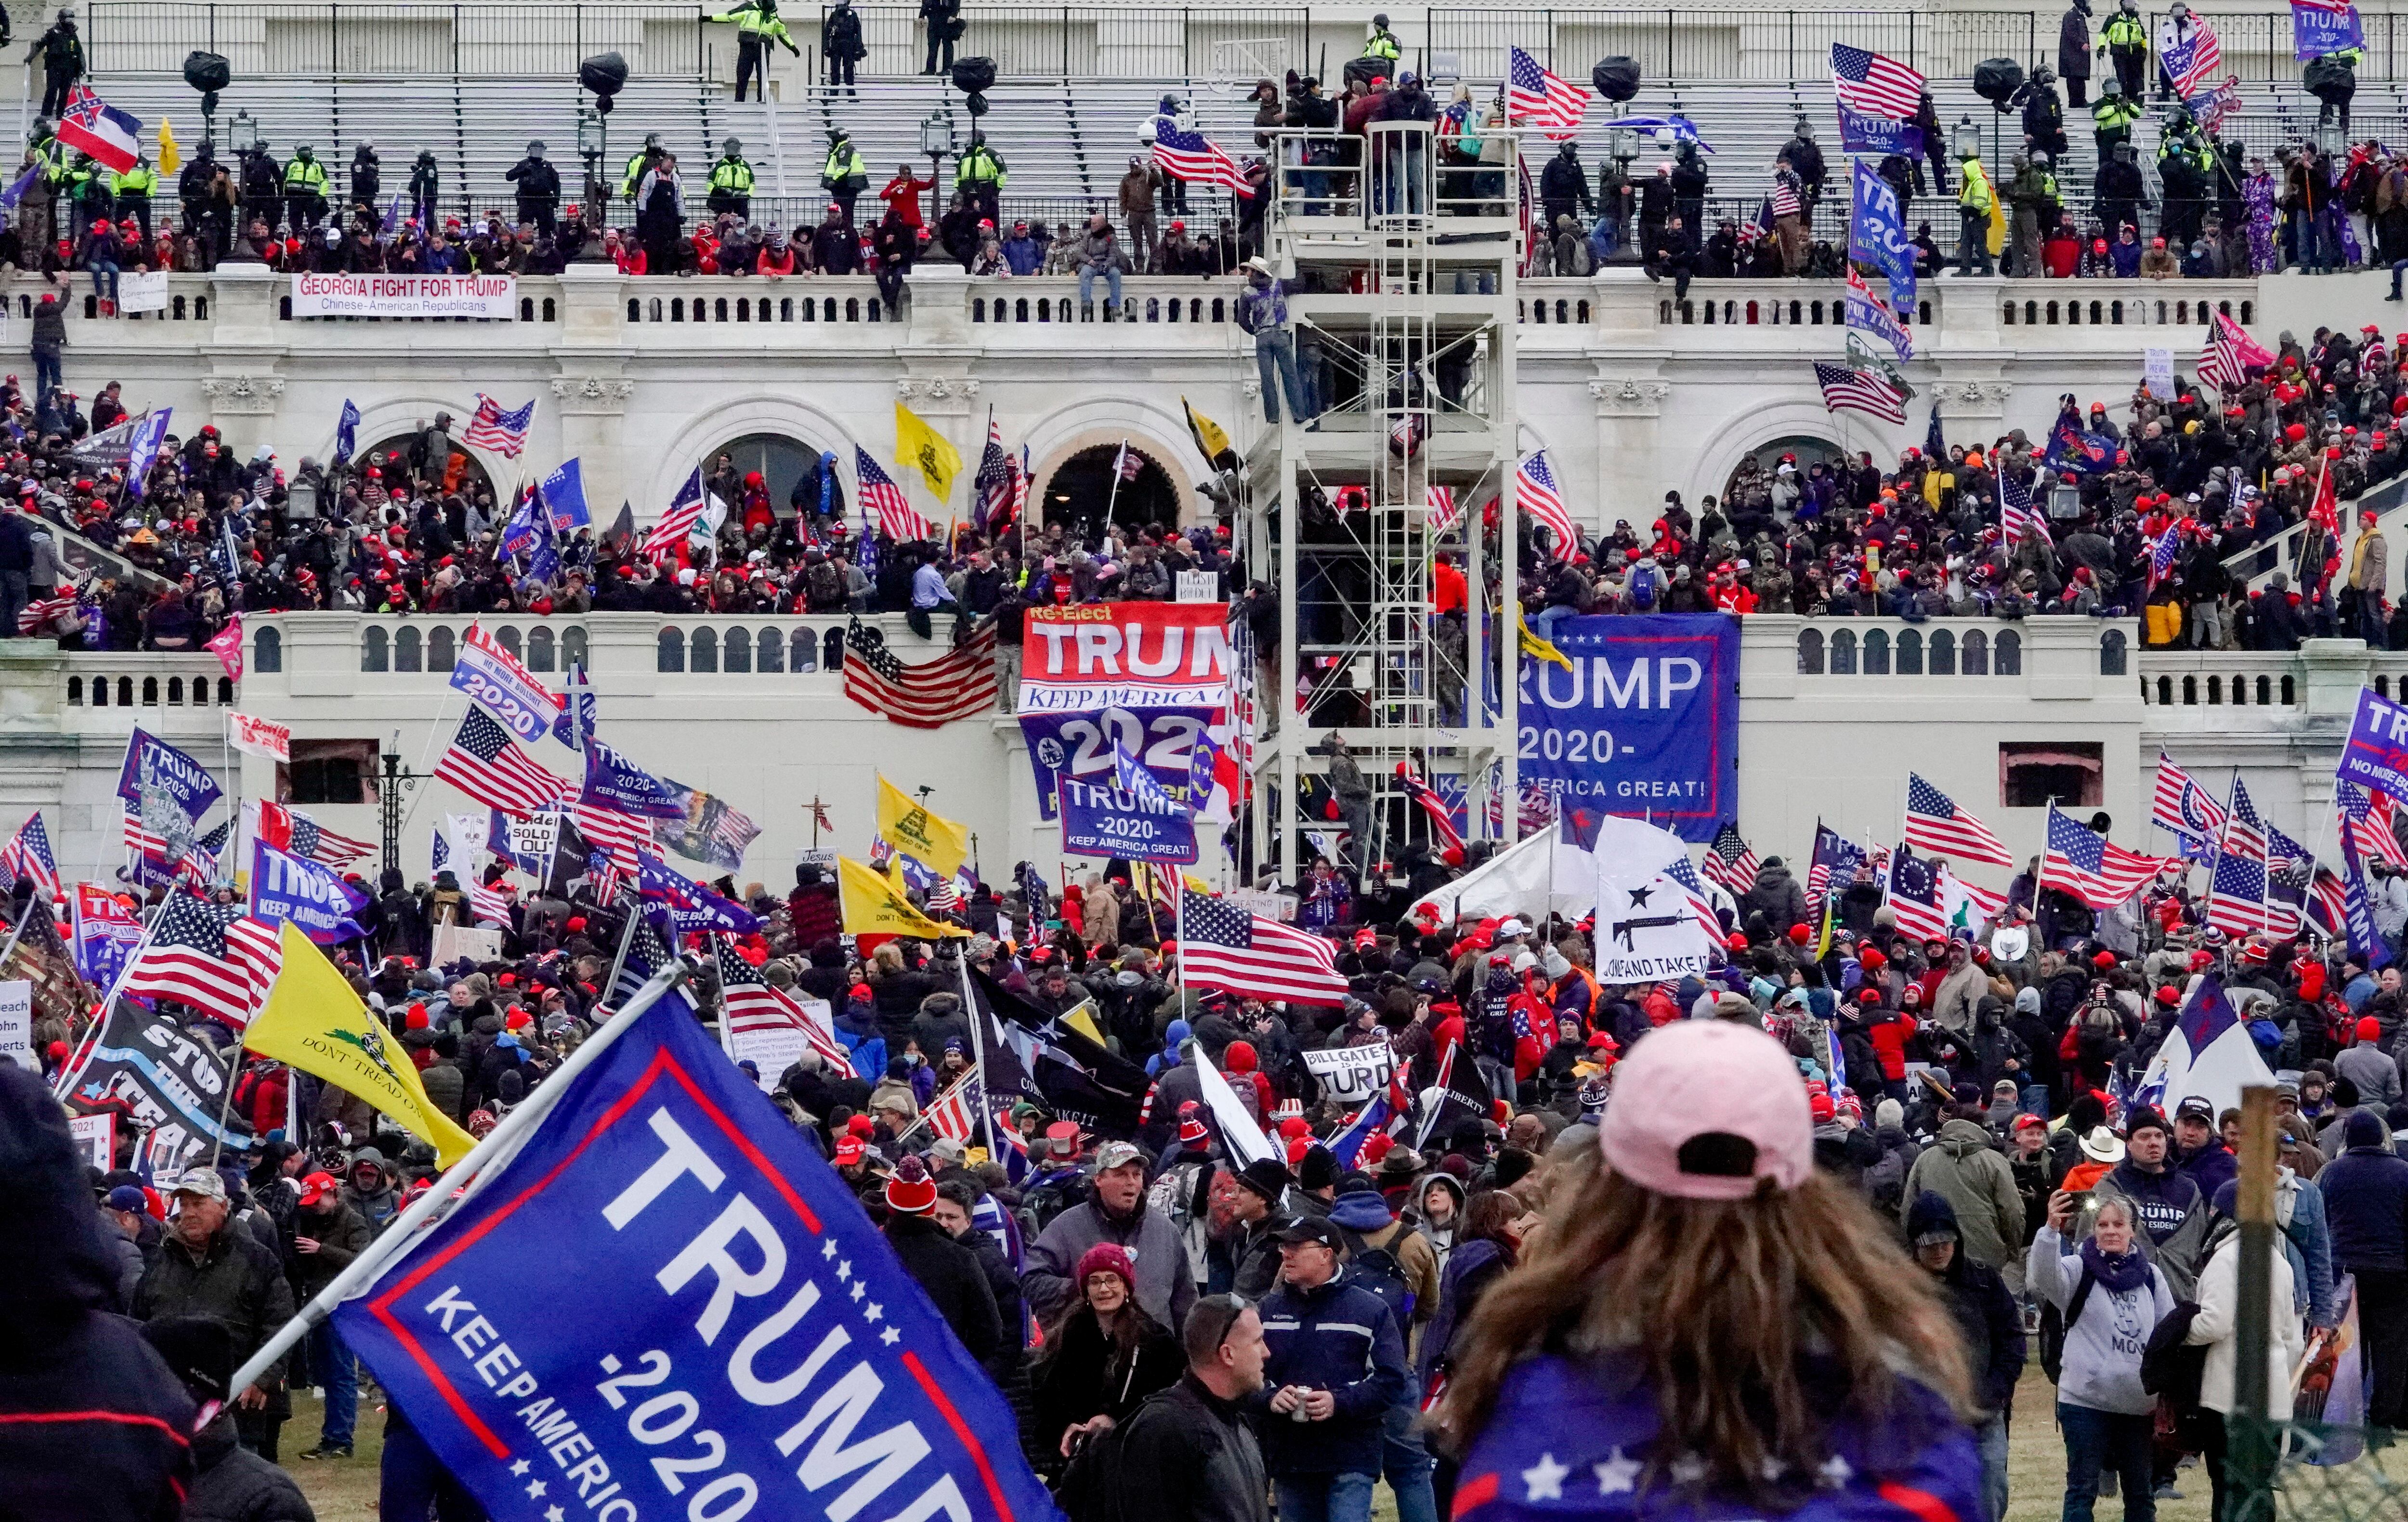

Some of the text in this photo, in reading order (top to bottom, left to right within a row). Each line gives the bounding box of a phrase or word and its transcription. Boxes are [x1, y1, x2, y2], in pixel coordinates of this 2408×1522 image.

[300, 278, 508, 297] GEORGIA FIGHT FOR TRUMP
[321, 298, 486, 313] Chinese-American Republicans
[1030, 605, 1112, 621] Re-Elect
[483, 658, 542, 708] NO MORE BULLSHIT
[1491, 656, 1702, 710] RUMP
[462, 674, 535, 734] 2020
[1027, 687, 1093, 708] KEEP
[1096, 687, 1207, 707] AMERICA
[145, 741, 213, 794] TRUMP
[2349, 758, 2372, 774] NO
[2371, 765, 2398, 783] MORE
[595, 786, 616, 797] KEEP
[615, 790, 645, 803] AMERICA
[1065, 779, 1188, 816] TRUMP
[1617, 781, 1705, 797] GREAT!
[512, 827, 550, 840] SOLD
[1096, 817, 1161, 839] -2020-
[561, 846, 585, 863] LIBERTY
[924, 848, 932, 856] ME
[1068, 836, 1189, 854] KEEP AMERICA GREAT!
[802, 849, 834, 863] Jesus
[259, 898, 291, 917] KEEP
[876, 913, 895, 922] DON'T
[1625, 959, 1653, 978] AND
[1655, 956, 1697, 975] TAKE
[0, 1000, 28, 1012] each
[2087, 1000, 2108, 1008] USA
[1305, 1044, 1390, 1065] BILL GATES
[302, 1037, 351, 1064] DONT
[354, 1059, 402, 1099] TREAD
[150, 1060, 202, 1111] THE
[1313, 1062, 1392, 1094] TURD
[1443, 1088, 1486, 1116] LIBERTY
[72, 1119, 95, 1132] 2021
[1081, 1113, 1098, 1128] IT
[154, 1169, 178, 1180] TREASON
[2140, 1206, 2186, 1221] RUMP
[424, 1285, 538, 1399] KEEP
